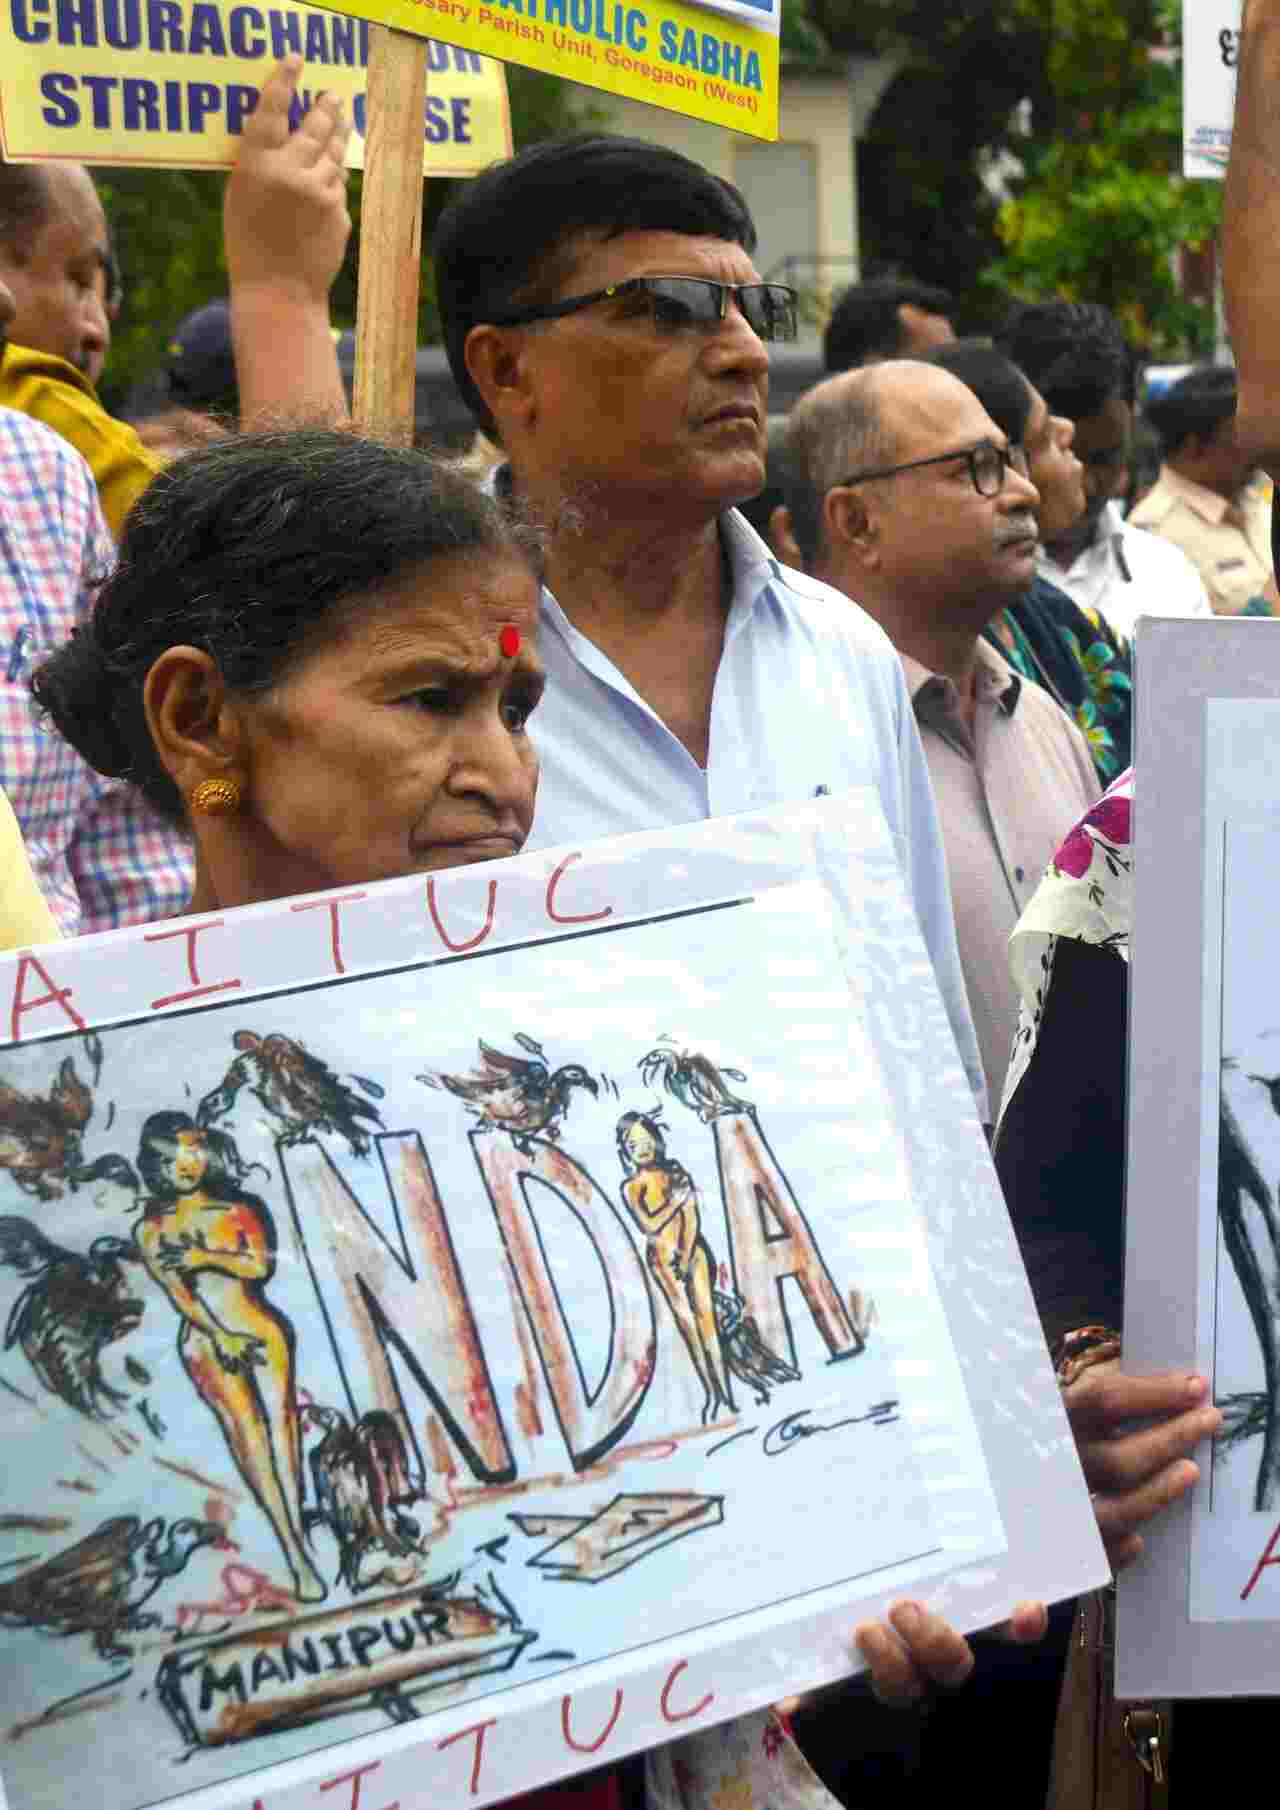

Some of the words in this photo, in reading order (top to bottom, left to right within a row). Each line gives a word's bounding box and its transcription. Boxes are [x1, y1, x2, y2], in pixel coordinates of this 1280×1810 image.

[478, 6, 545, 44] Parish
[552, 30, 598, 66] Unit,
[605, 47, 698, 93] Goregaon
[703, 80, 760, 116] (West)
[660, 19, 764, 91] SABHA
[11, 852, 614, 1041] AITUC
[199, 1605, 456, 1711] MANIPUR
